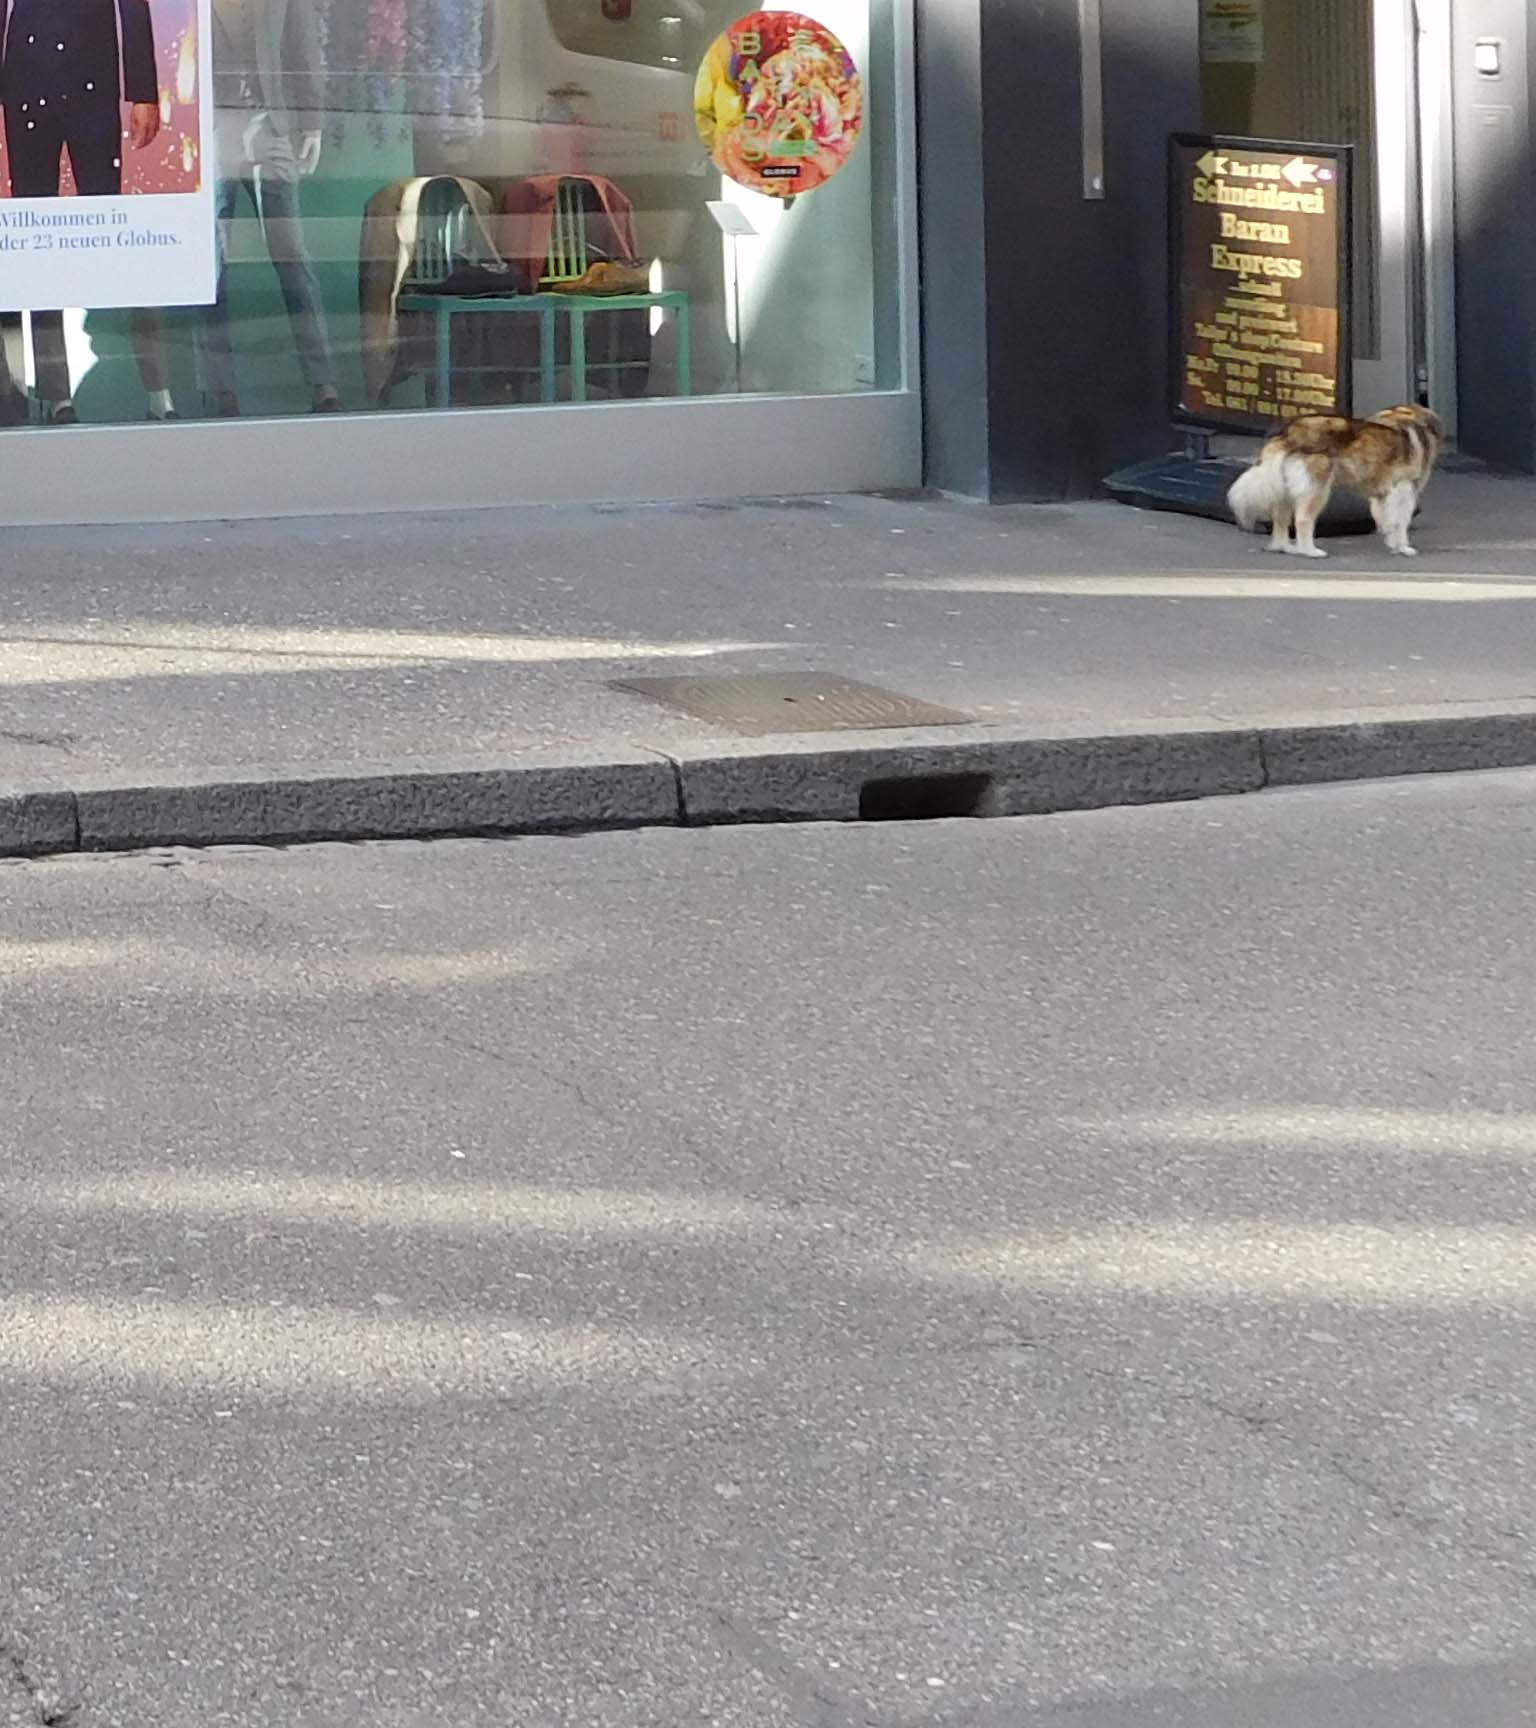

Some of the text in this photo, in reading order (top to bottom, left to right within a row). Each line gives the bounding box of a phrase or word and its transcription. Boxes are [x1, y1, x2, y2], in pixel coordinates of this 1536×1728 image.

[1192, 176, 1326, 215] Schneiderei
[111, 208, 129, 225] in
[1219, 211, 1291, 245] Baran
[32, 234, 54, 250] 23
[58, 233, 112, 249] neuen
[116, 229, 183, 247] Globus.
[1210, 244, 1303, 280] Express
